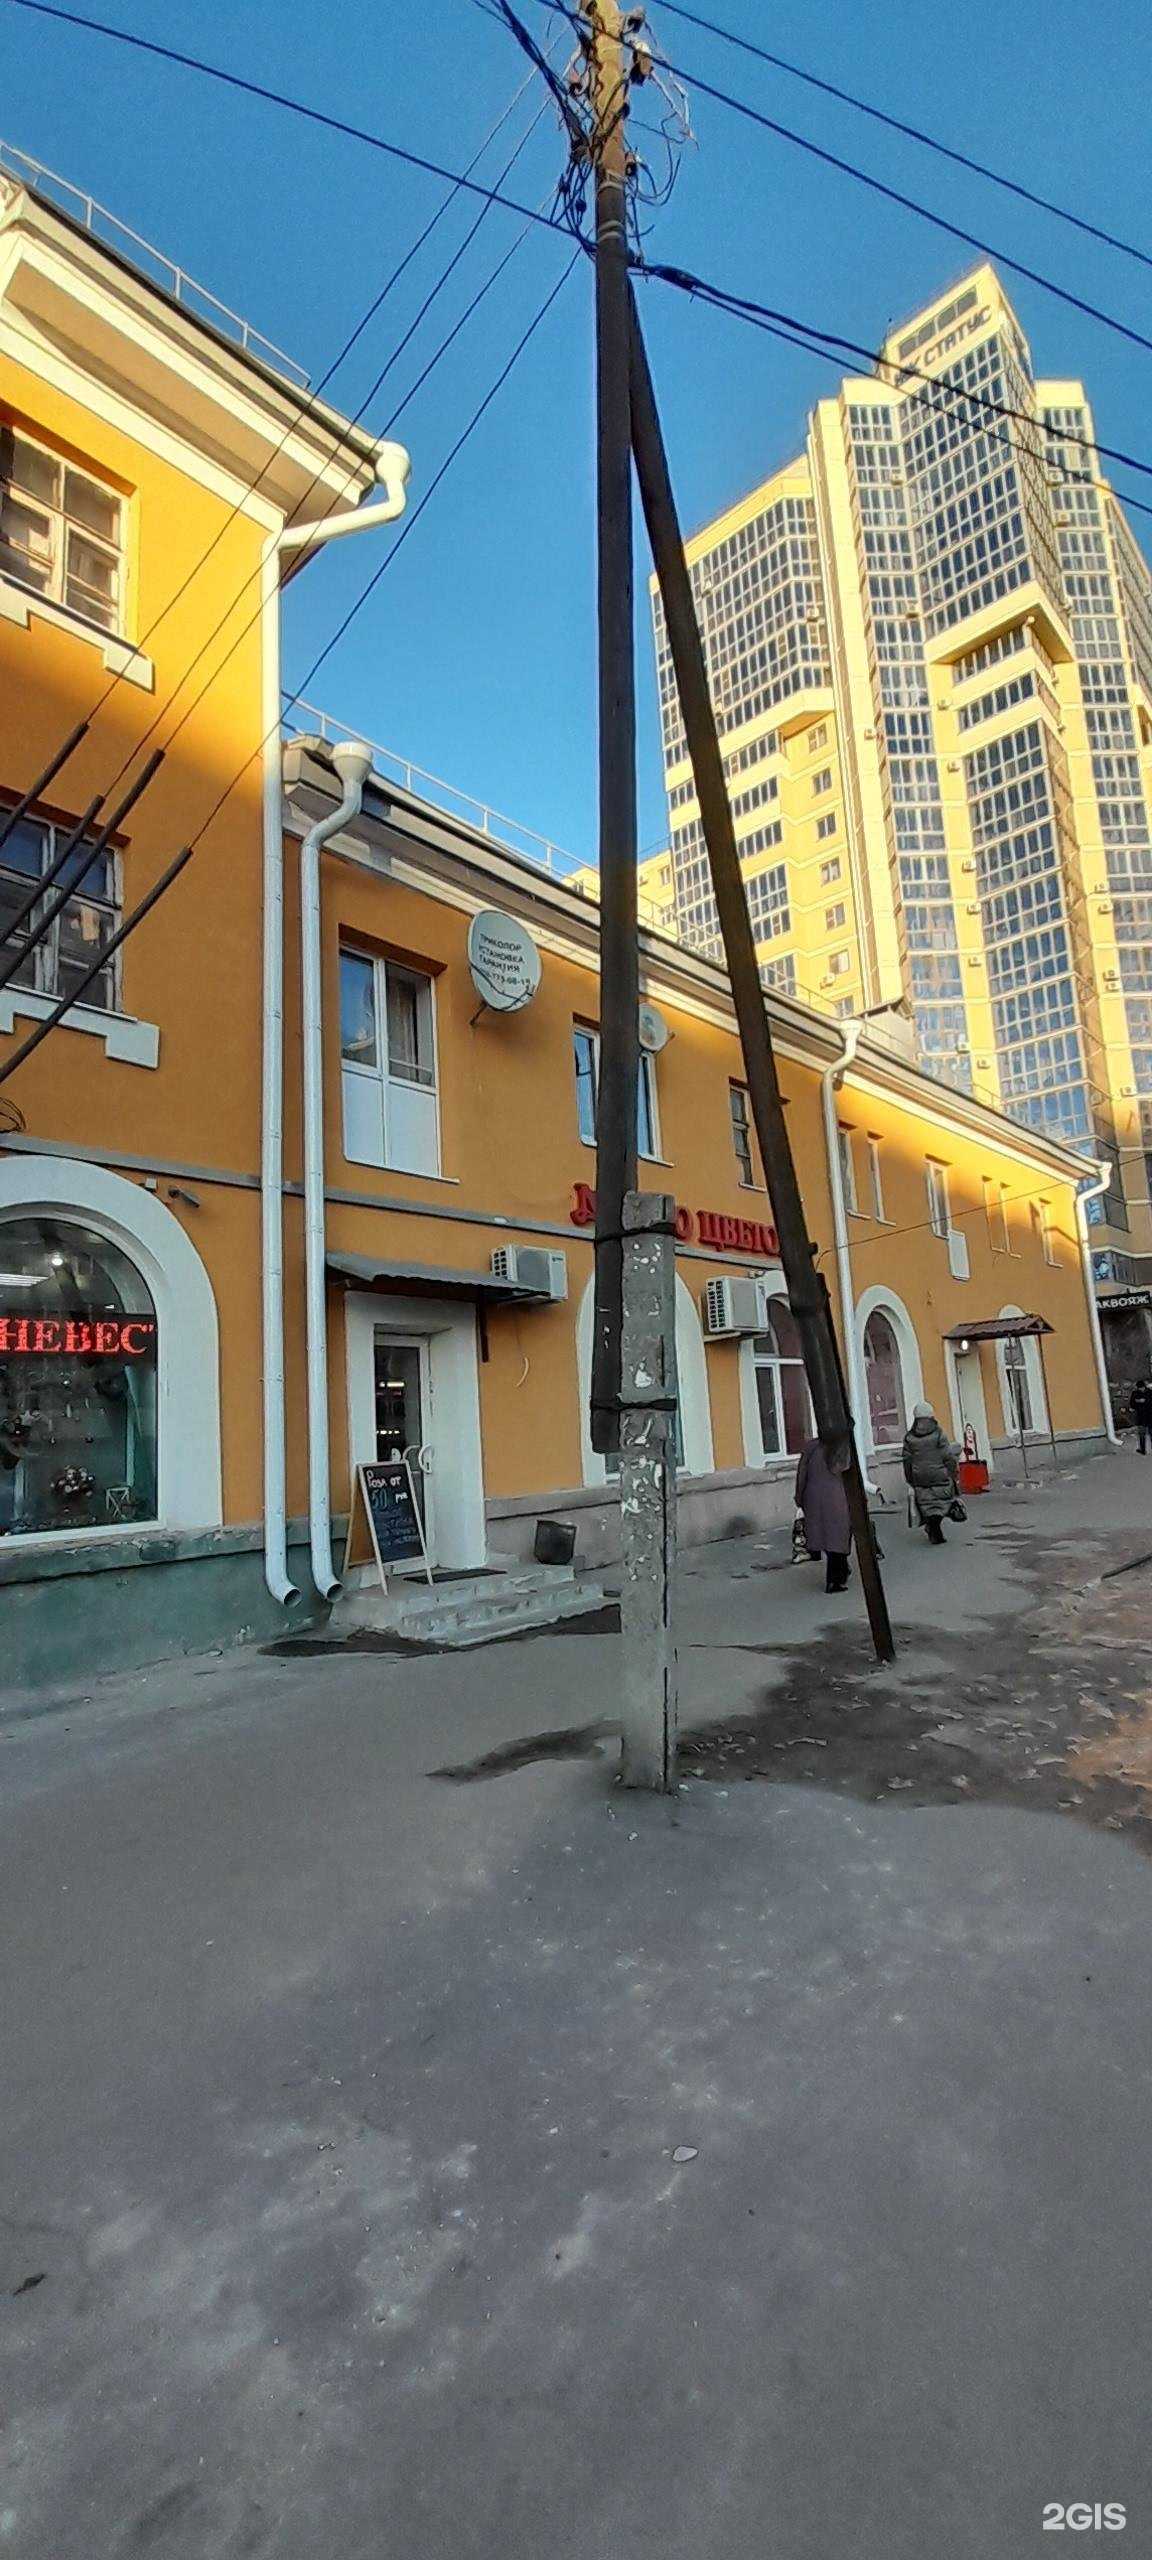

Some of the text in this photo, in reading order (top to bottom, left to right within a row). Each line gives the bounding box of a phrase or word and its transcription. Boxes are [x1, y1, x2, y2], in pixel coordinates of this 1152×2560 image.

[924, 305, 992, 366] СТАТУС
[696, 1210, 780, 1258] ЦВЕТО
[1096, 1295, 1150, 1309] АКВОЯЖ
[0, 1318, 153, 1354] НЕВЕС
